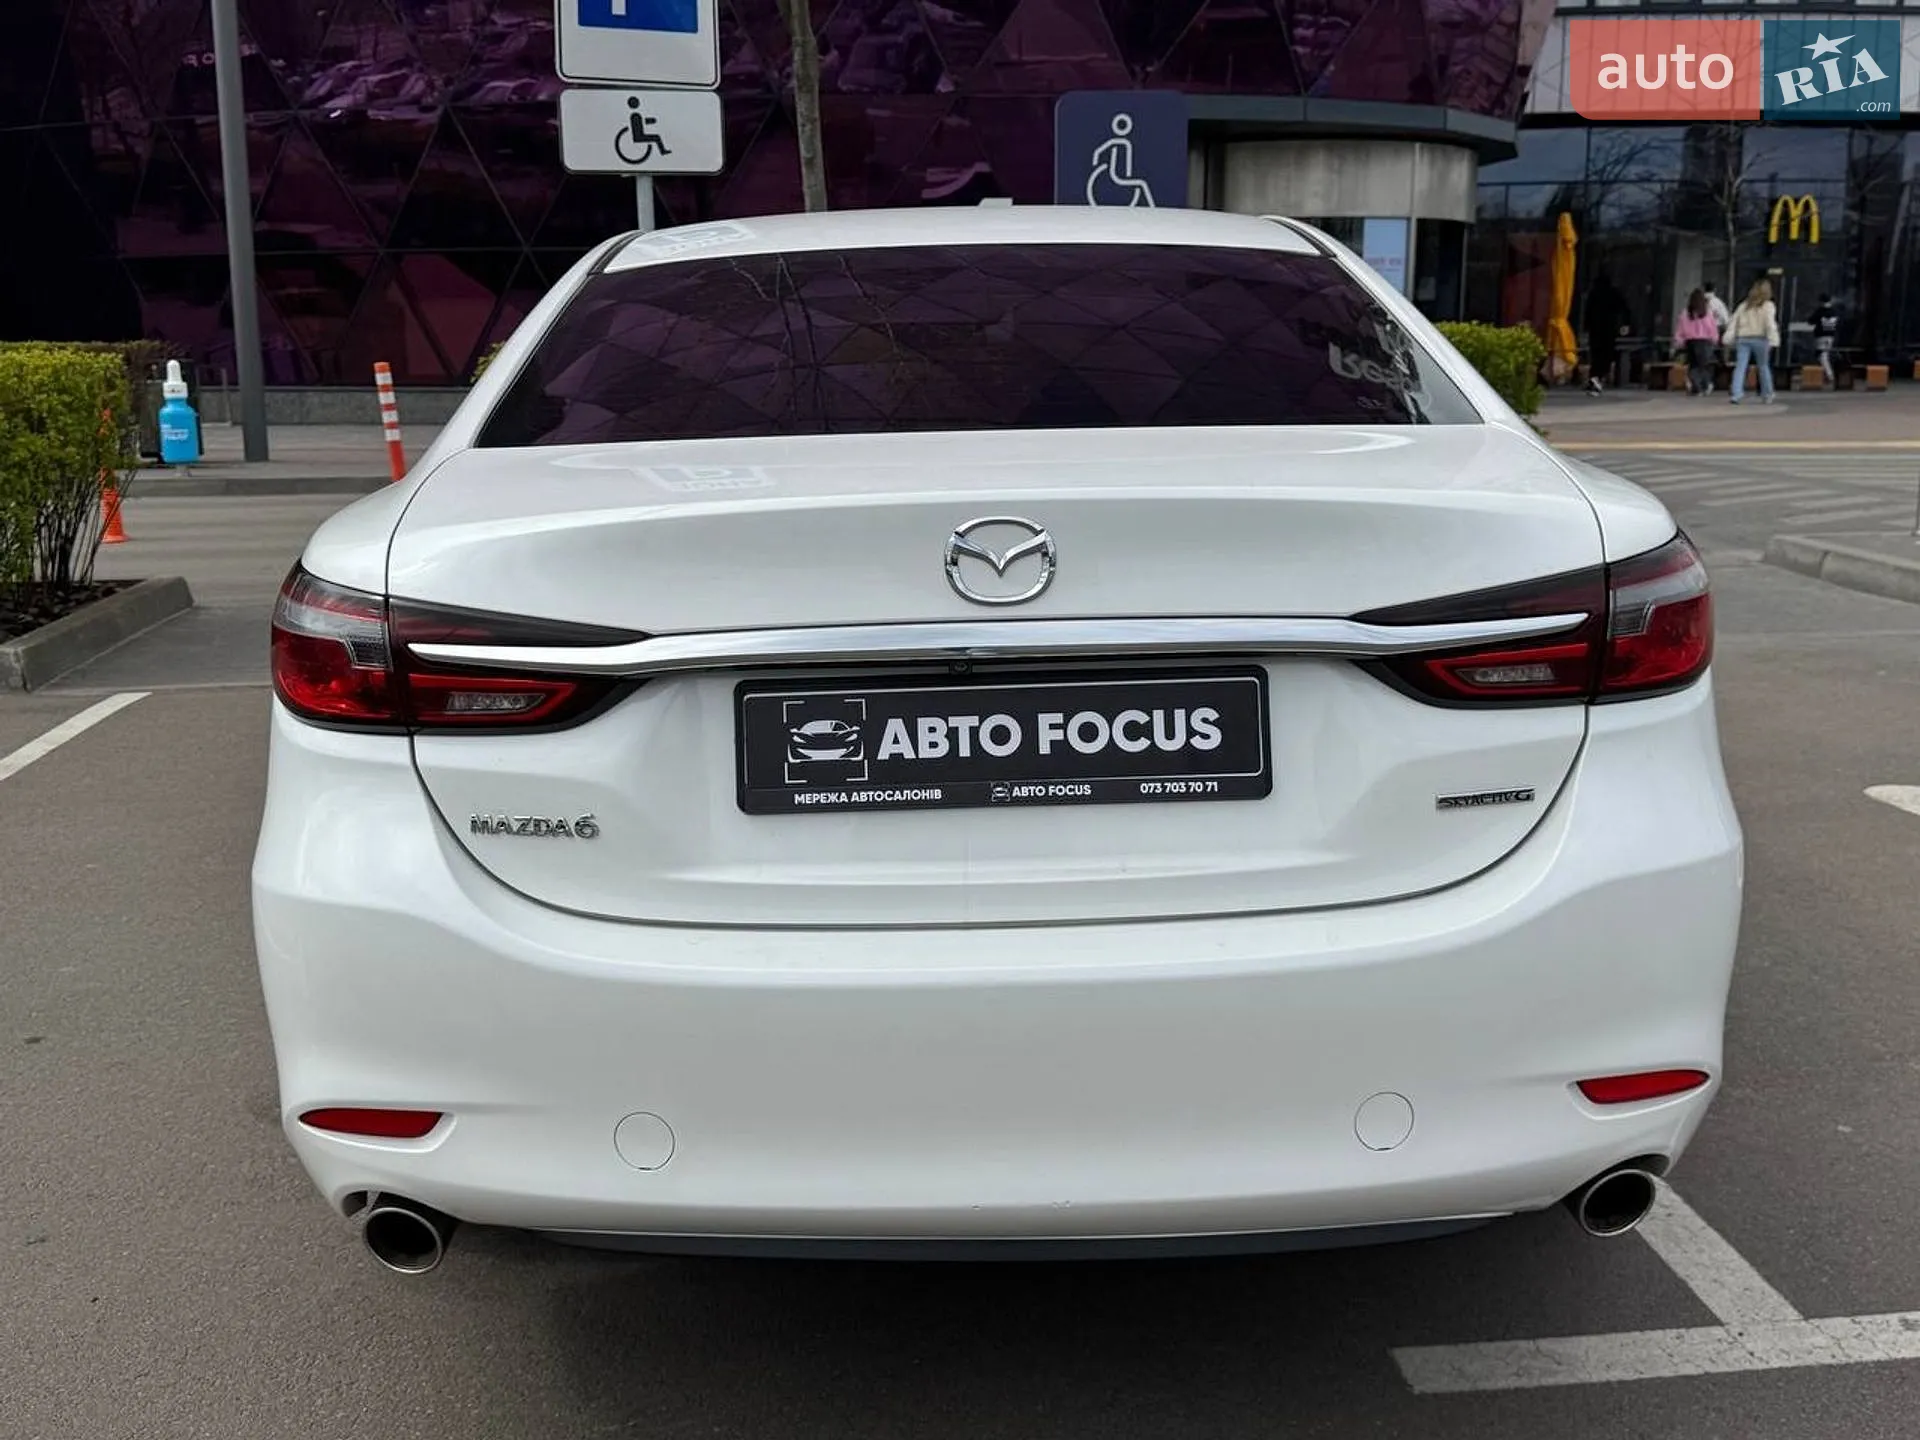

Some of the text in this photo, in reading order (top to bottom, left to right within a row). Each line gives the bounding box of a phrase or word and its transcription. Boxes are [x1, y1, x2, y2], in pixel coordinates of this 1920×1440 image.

[877, 707, 1223, 761] АВТО FOCUS
[1012, 784, 1092, 797] АВТО FOCUS
[1140, 781, 1218, 793] 073 703 70 71
[794, 788, 942, 805] МЕРЕЖА АВТОСАЛОНІВ
[470, 813, 600, 838] MAZDA6
